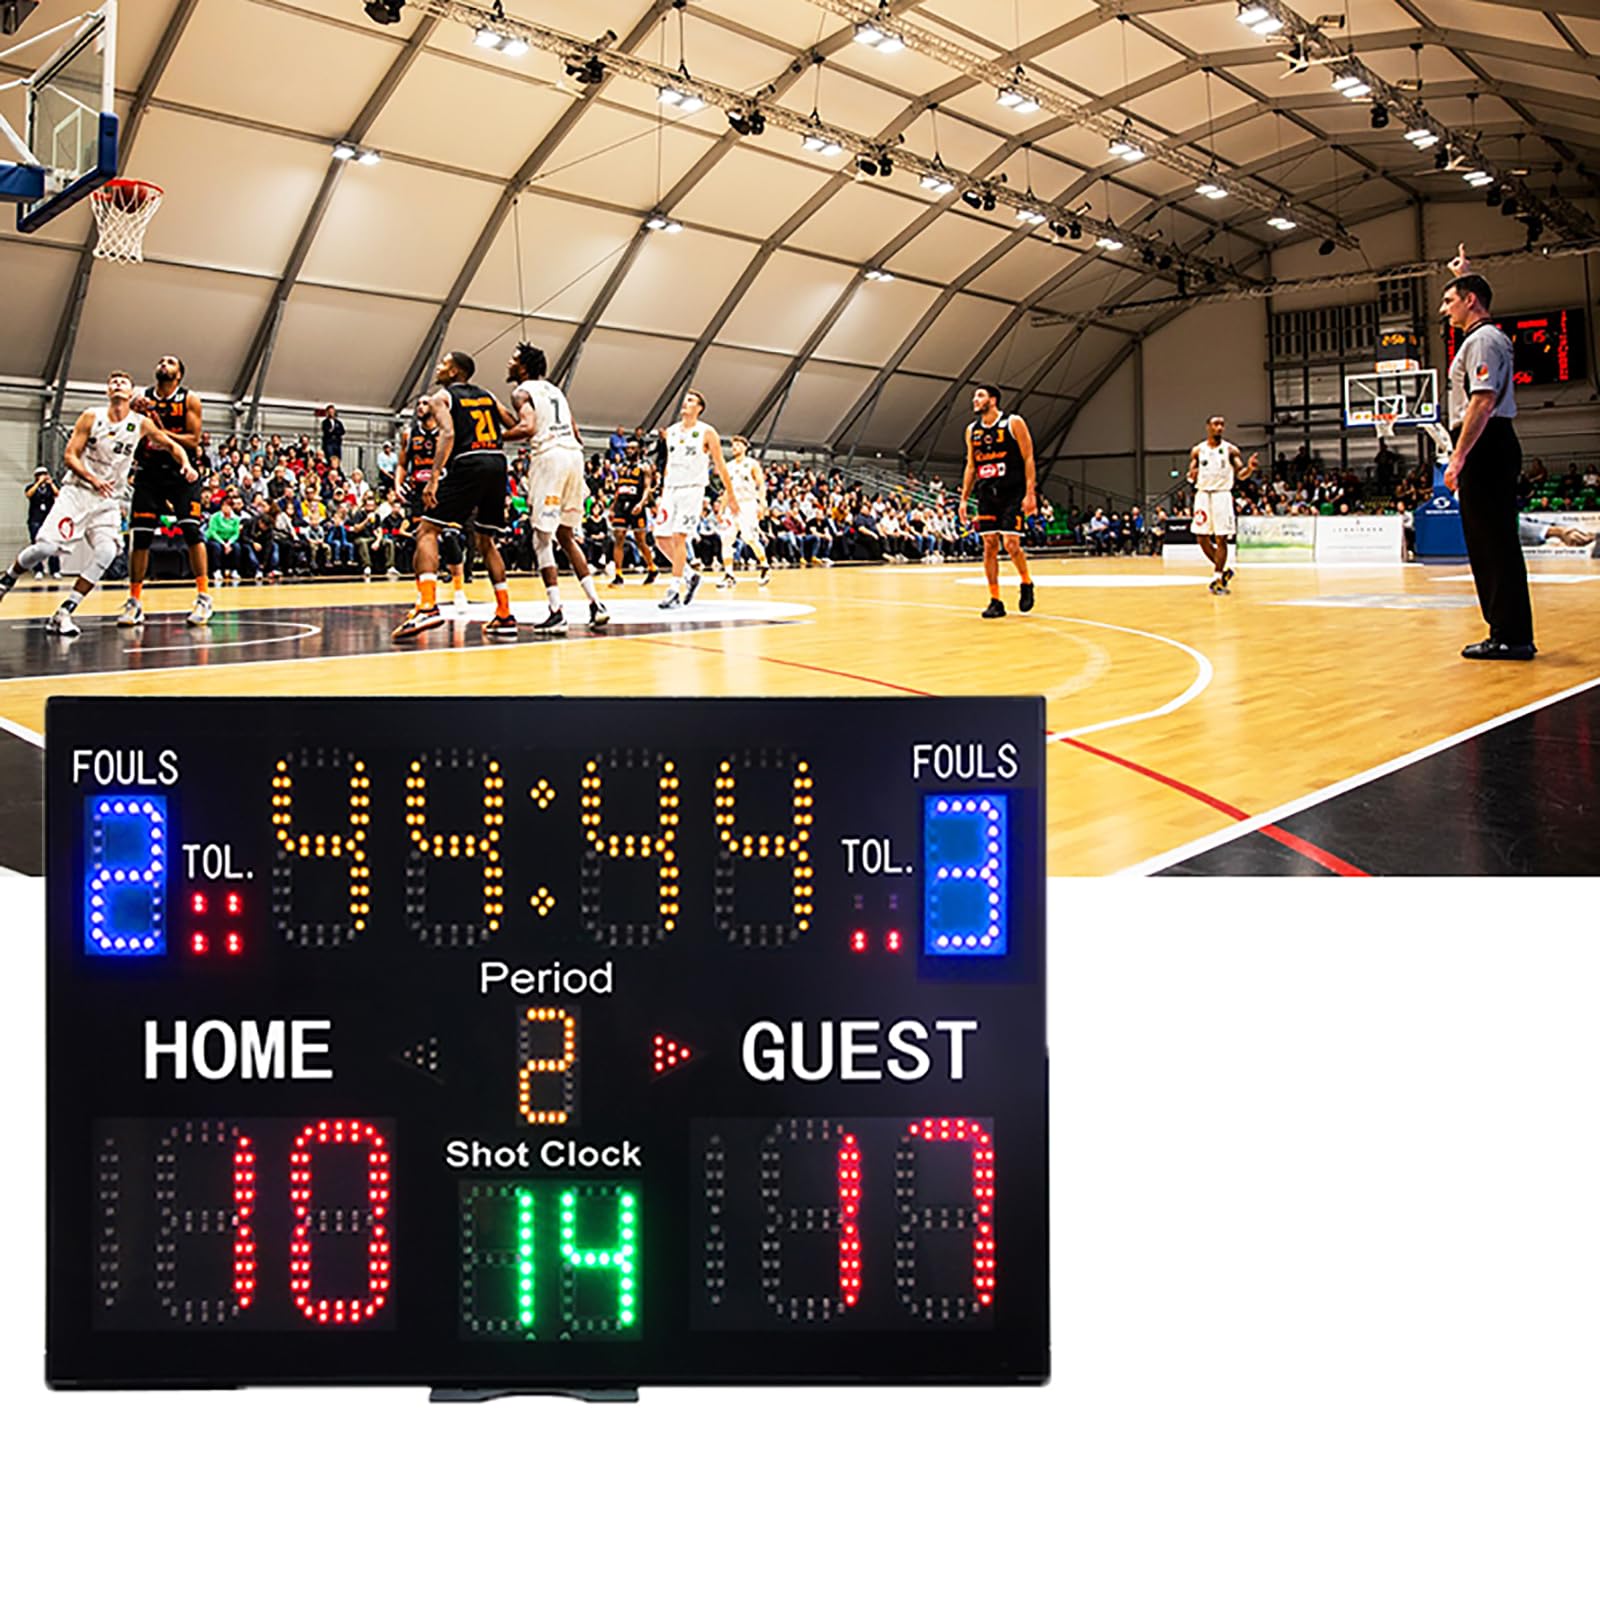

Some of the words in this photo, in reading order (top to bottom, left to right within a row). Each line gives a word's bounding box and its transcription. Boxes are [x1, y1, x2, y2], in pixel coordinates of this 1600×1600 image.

[113, 441, 134, 456] 25
[470, 409, 498, 442] 21
[74, 750, 178, 785] FOULS
[914, 744, 1017, 778] FOULS
[90, 797, 167, 953] 2
[183, 844, 253, 879] TOL.
[842, 839, 912, 873] TOL.
[930, 796, 1003, 953] 3
[482, 962, 612, 993] Period
[146, 1020, 332, 1079] HOME
[520, 1009, 574, 1122] 2
[743, 1021, 977, 1080] GUEST
[447, 1141, 529, 1167] Shot
[541, 1141, 641, 1166] Clock
[233, 1120, 390, 1323] 10
[839, 1118, 995, 1305] 17
[516, 1189, 637, 1326] 14
